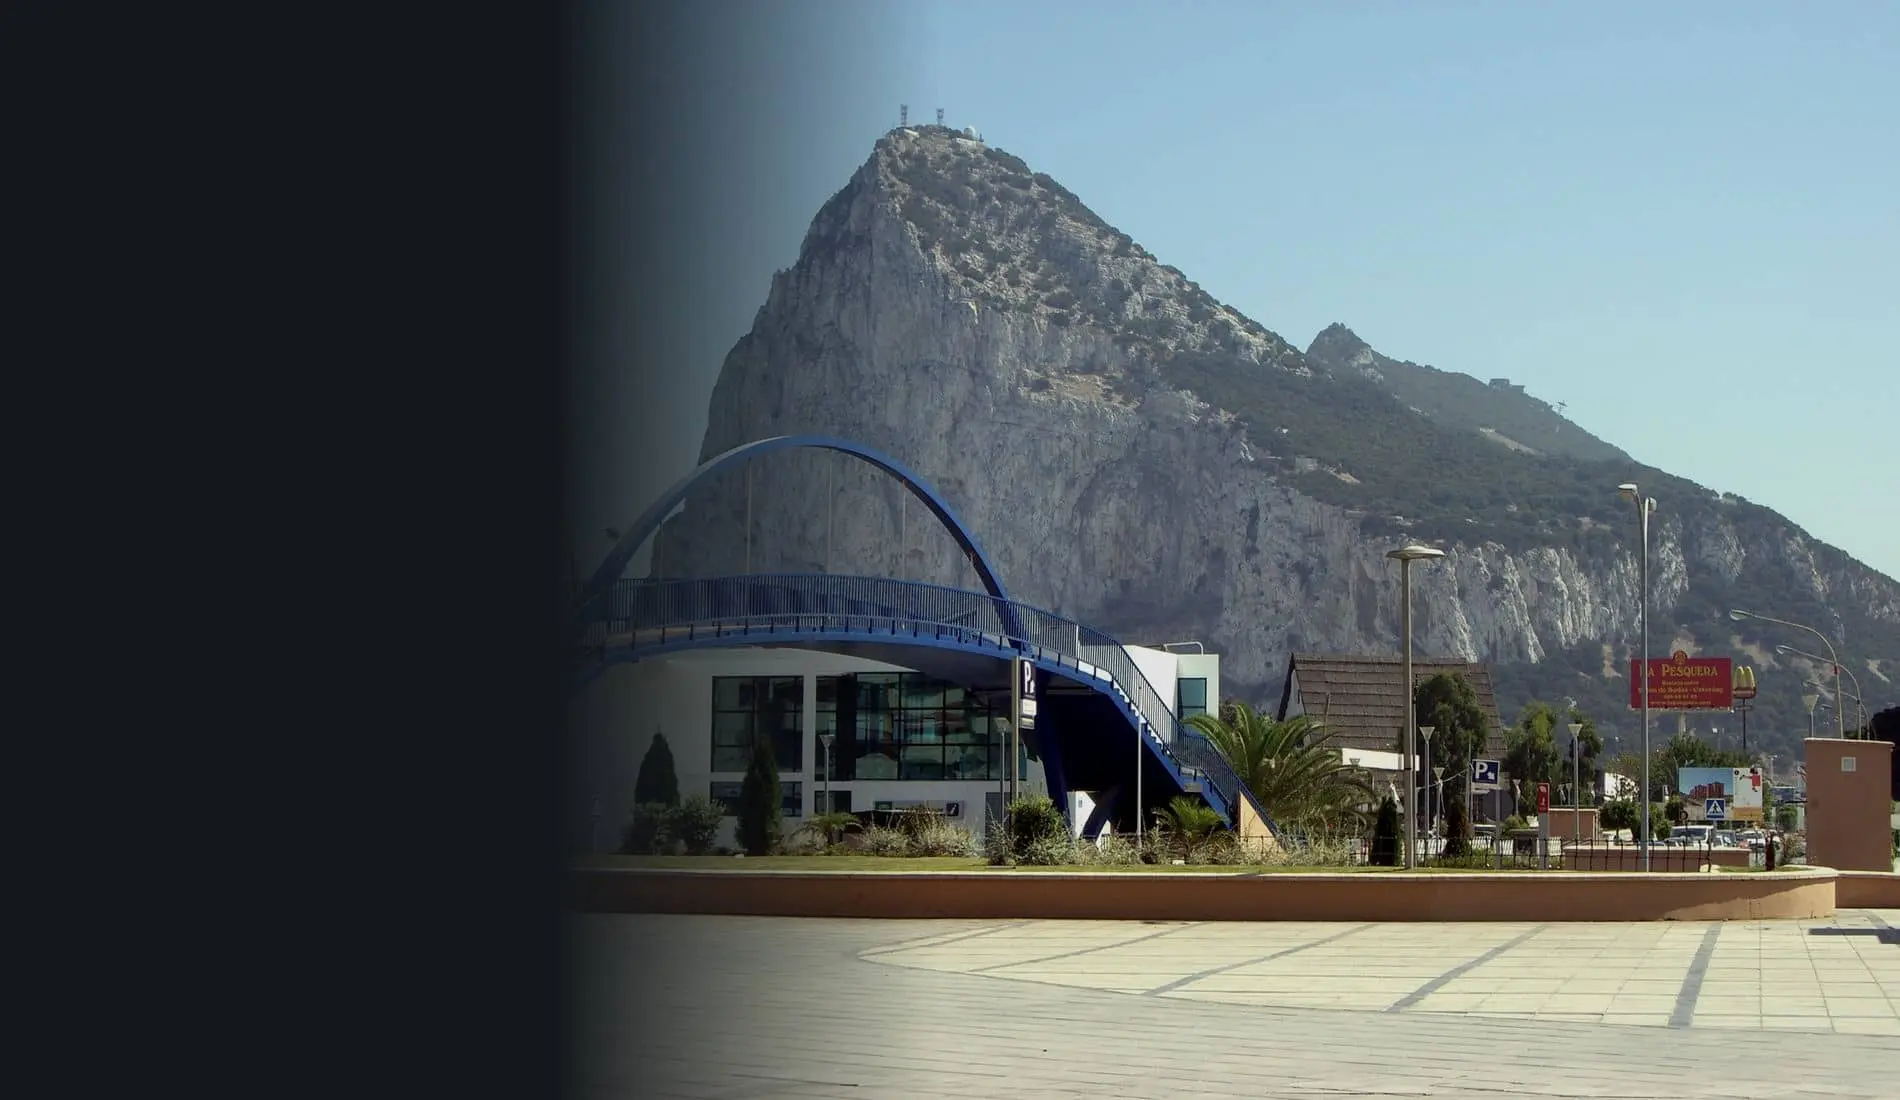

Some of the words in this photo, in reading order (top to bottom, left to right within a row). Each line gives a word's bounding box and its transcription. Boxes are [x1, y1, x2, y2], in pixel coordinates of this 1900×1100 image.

[1024, 661, 1032, 693] P
[1661, 663, 1718, 677] PESQUERA
[1475, 761, 1488, 779] P
